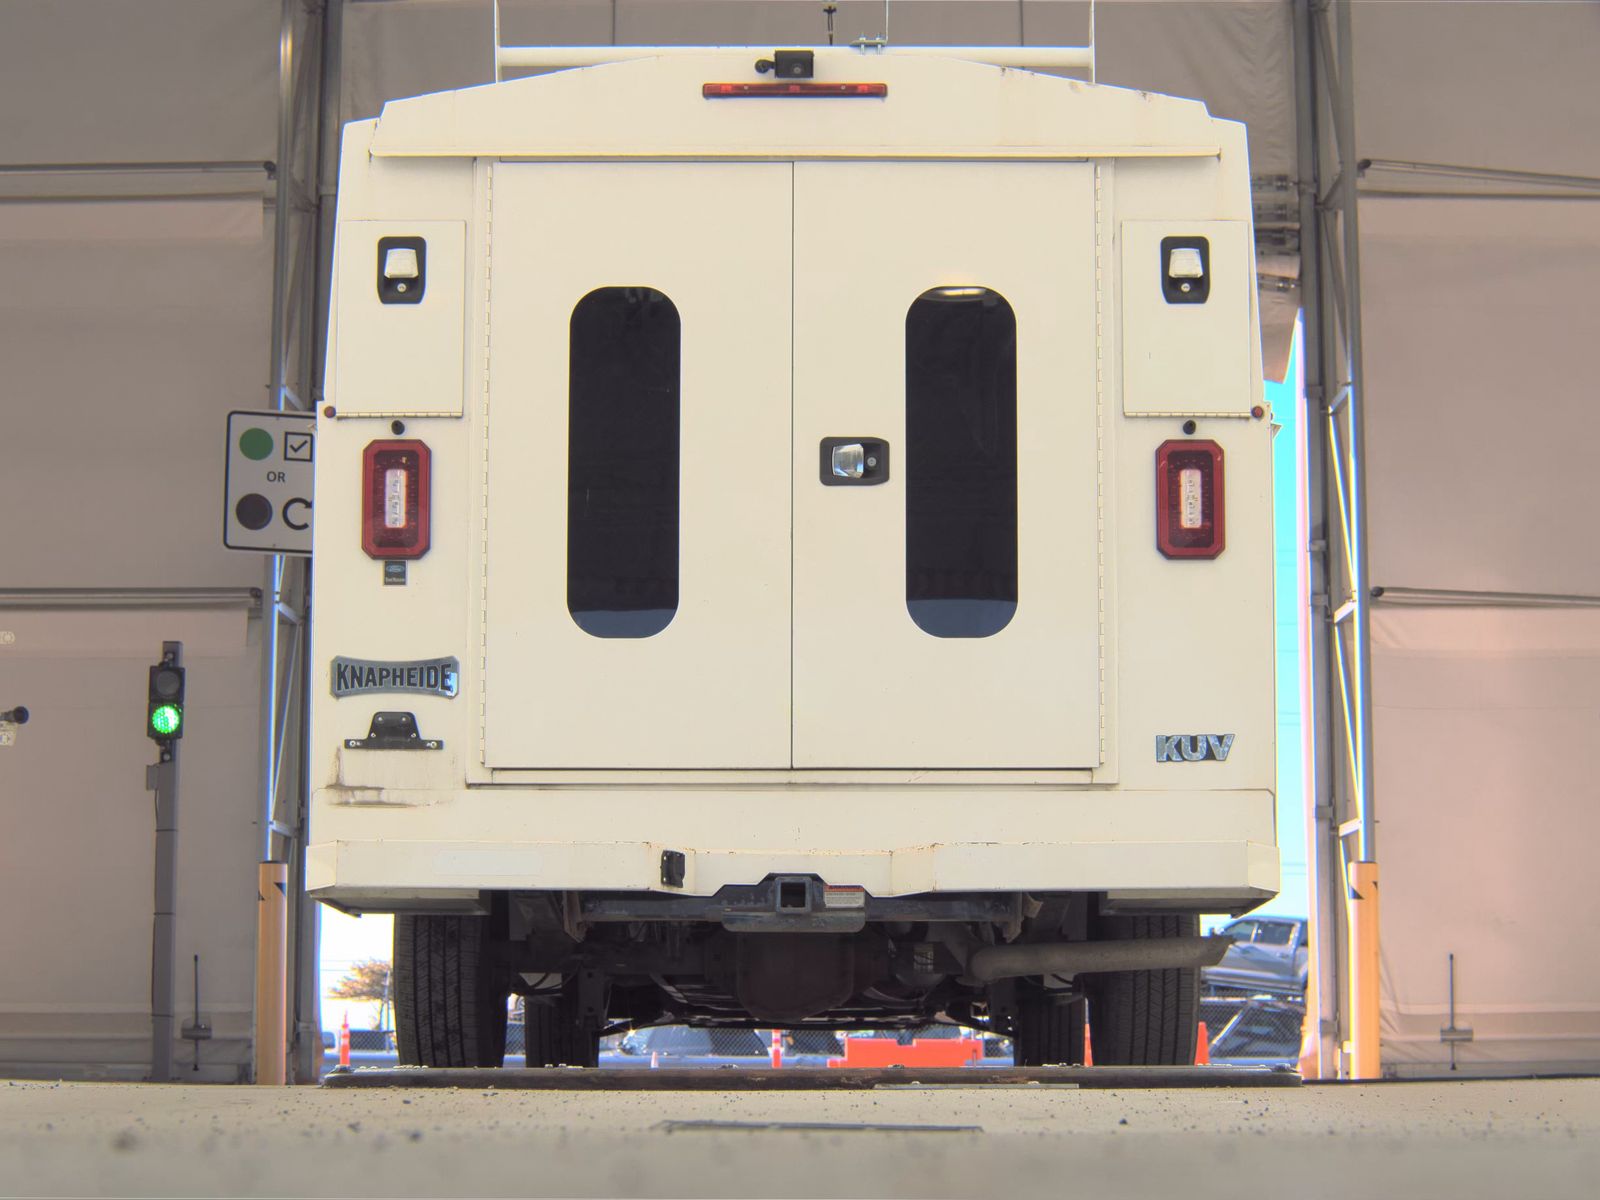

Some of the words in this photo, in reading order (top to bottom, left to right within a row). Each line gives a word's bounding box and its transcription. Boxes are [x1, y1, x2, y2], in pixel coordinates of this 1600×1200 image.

[266, 471, 286, 483] OR
[336, 663, 454, 692] KNAPHEIDE
[1156, 734, 1235, 762] KUV
